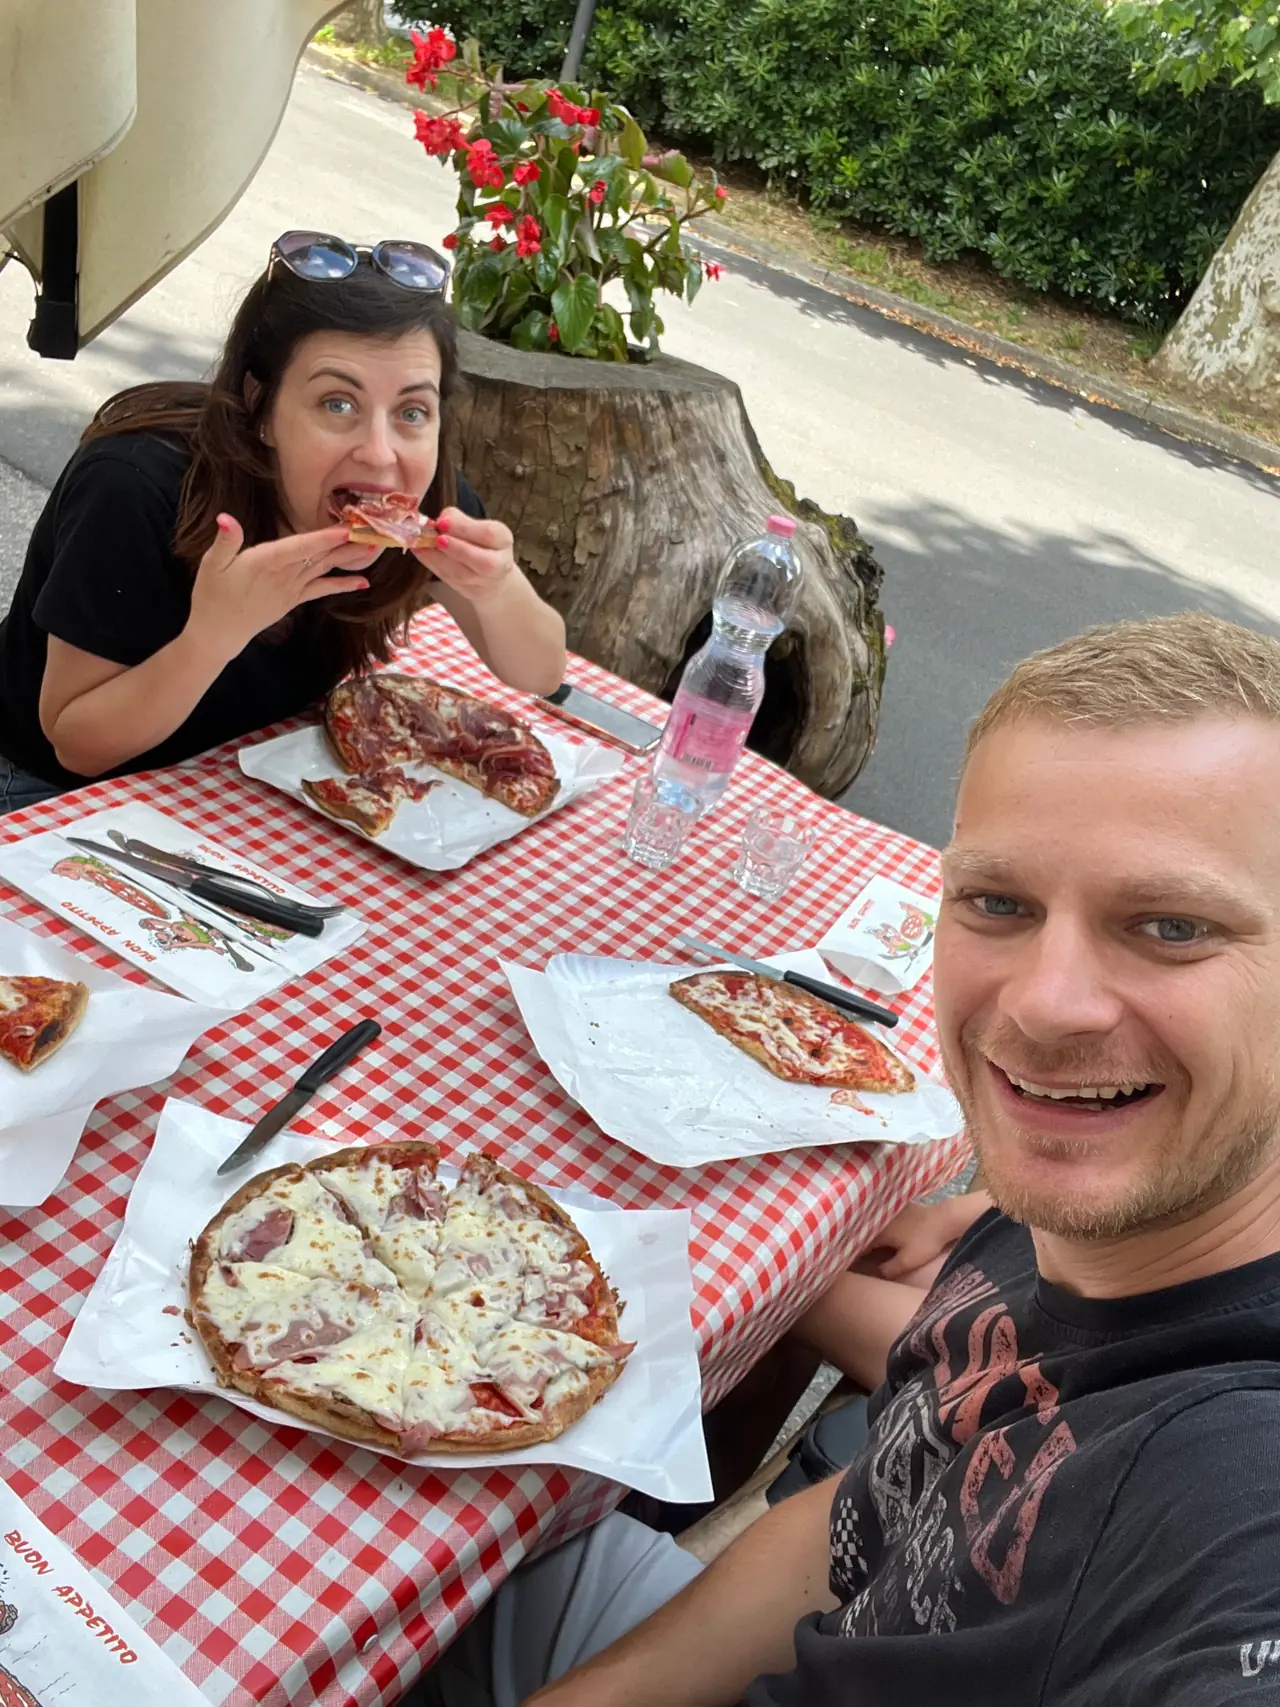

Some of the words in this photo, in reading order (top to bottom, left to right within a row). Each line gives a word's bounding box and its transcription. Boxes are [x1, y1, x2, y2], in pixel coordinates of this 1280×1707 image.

[231, 864, 286, 894] APPETITO
[61, 901, 121, 935] APPETITO
[121, 939, 157, 962] BUON
[4, 1529, 54, 1575] BUON
[51, 1585, 138, 1664] APPETITO
